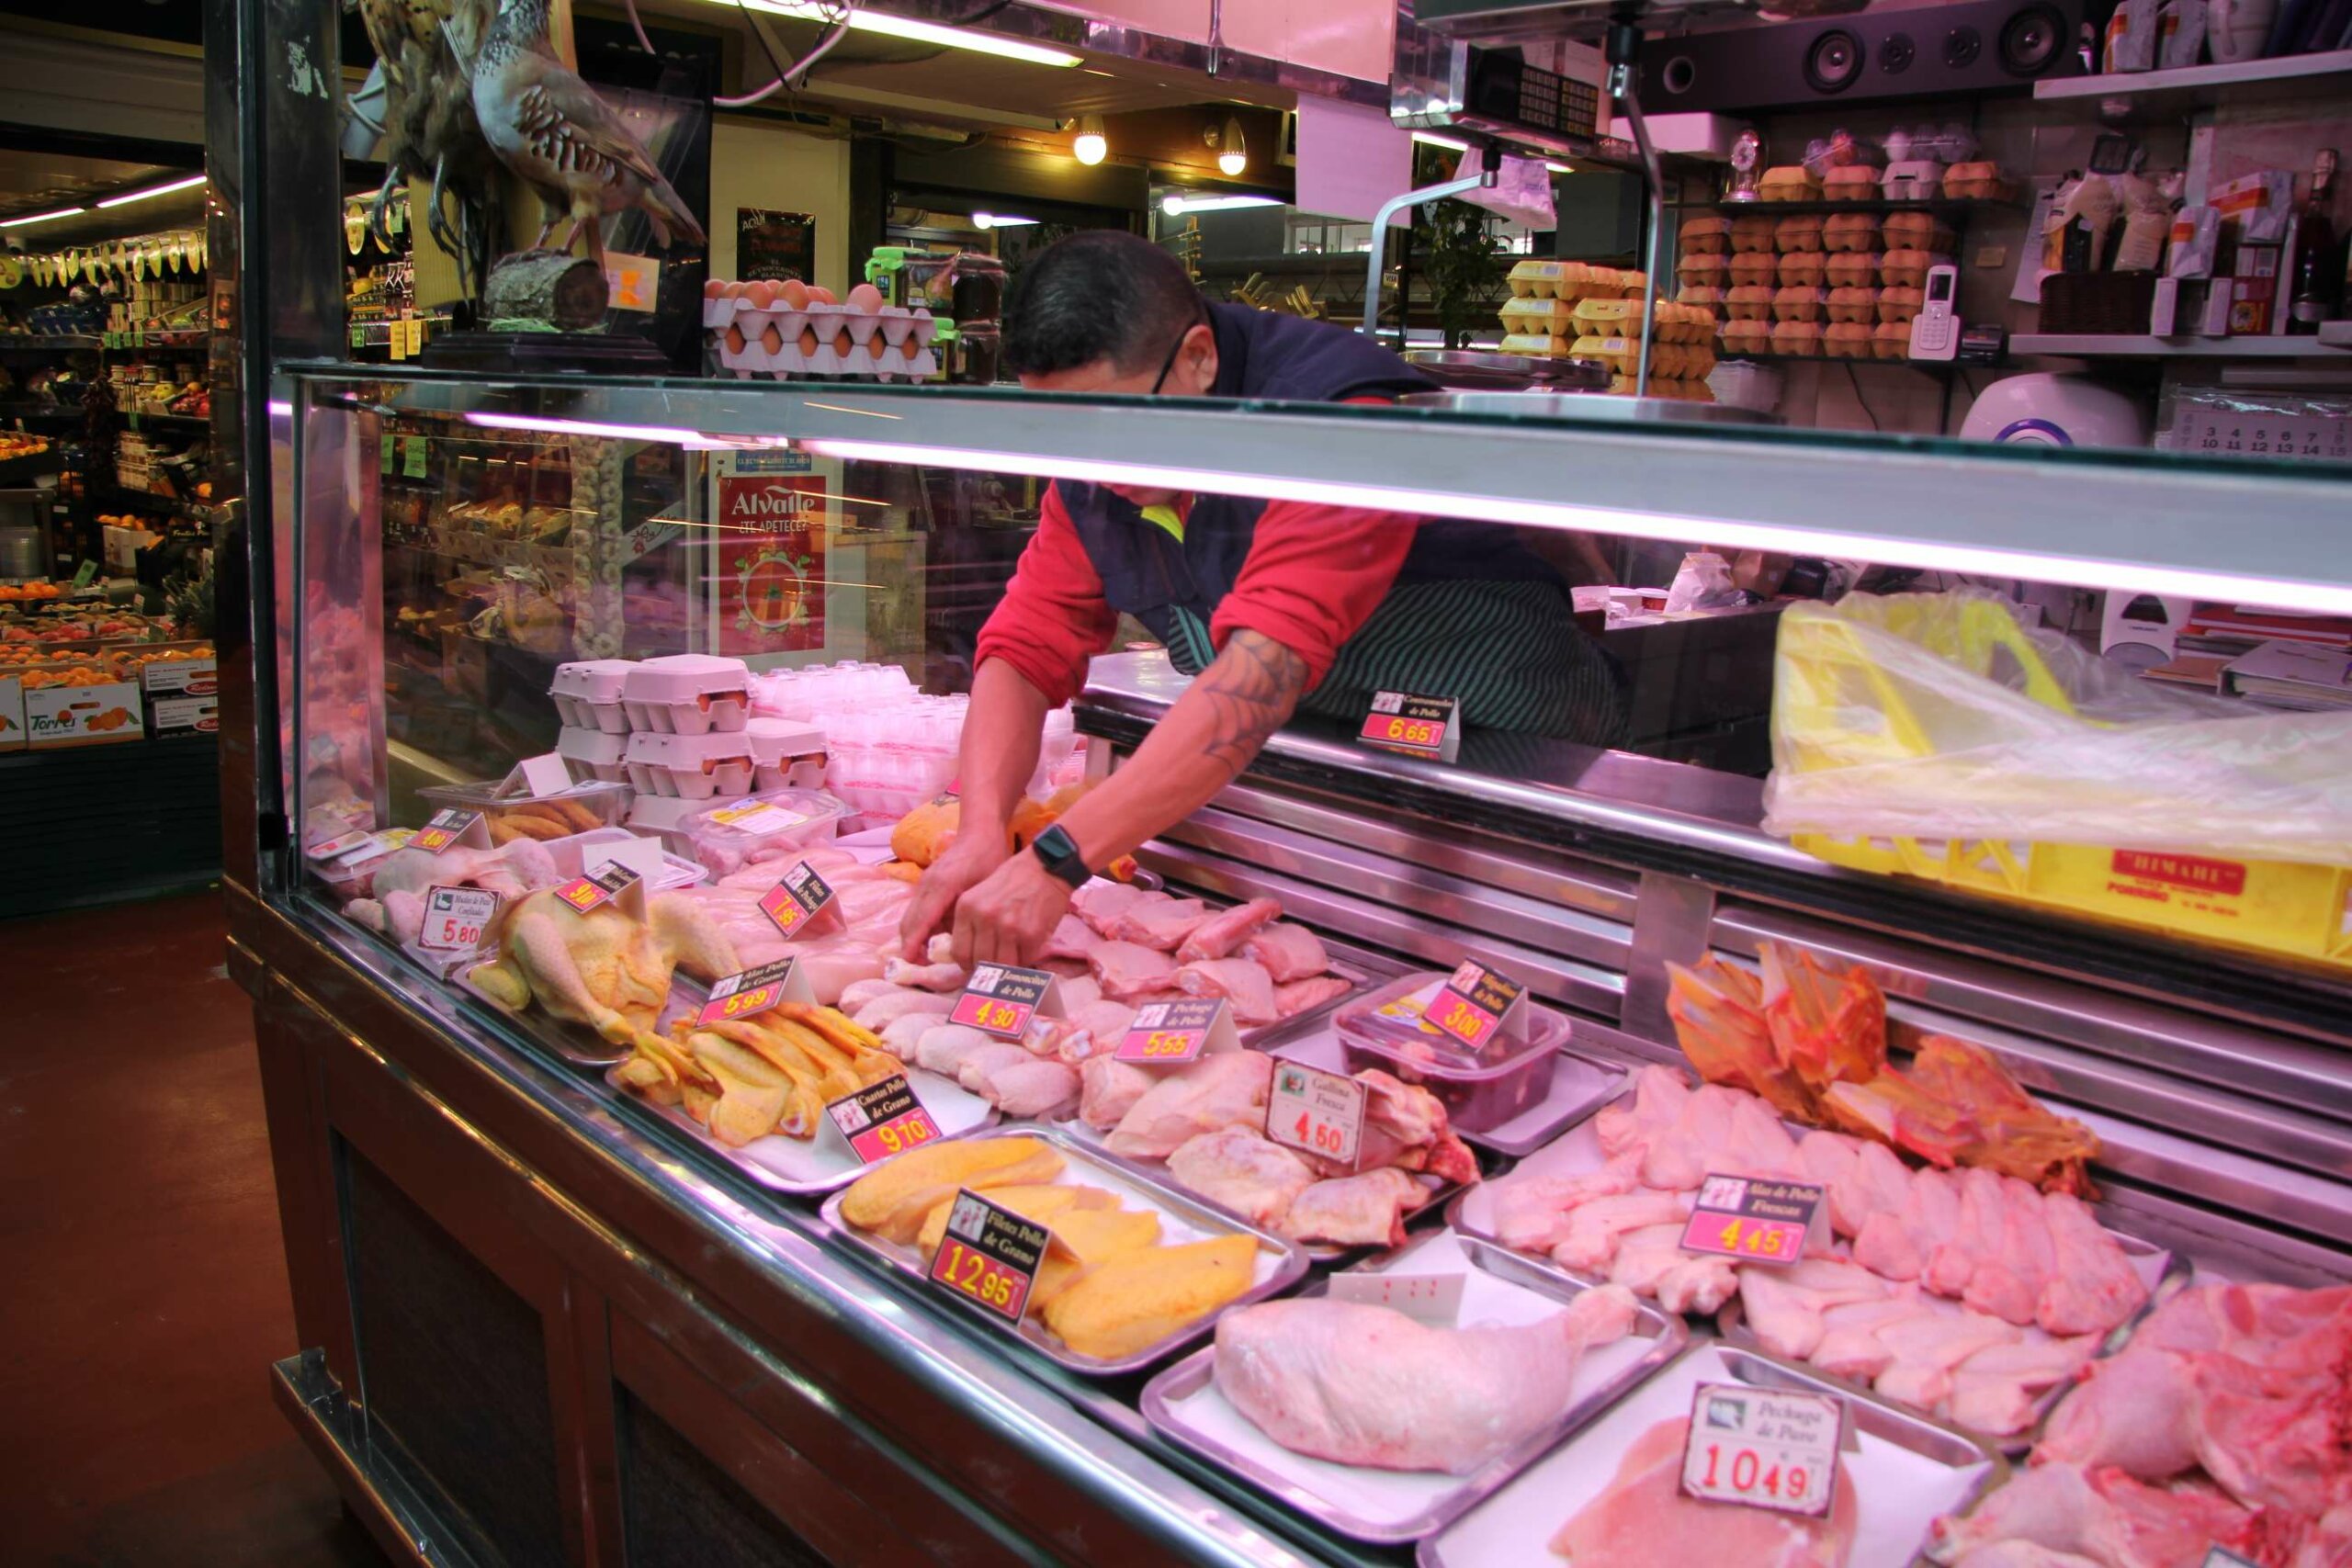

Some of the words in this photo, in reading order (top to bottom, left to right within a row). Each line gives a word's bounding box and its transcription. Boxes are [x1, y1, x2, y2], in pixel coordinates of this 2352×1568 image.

[2207, 427, 2216, 436] 3
[2231, 428, 2241, 438] 4
[2256, 430, 2266, 440] 5
[2280, 431, 2290, 441] 6
[2308, 433, 2317, 442] 7
[2201, 439, 2219, 449] 10
[2226, 440, 2242, 450] 11
[2251, 442, 2268, 452] 12
[2276, 444, 2293, 454] 13
[2301, 446, 2319, 455] 14
[731, 485, 815, 515] Alvalle
[759, 519, 807, 534] APETECE?
[1012, 986, 1035, 998] Pollo
[887, 1077, 908, 1095] Pollo
[871, 1107, 883, 1119] de
[883, 1095, 911, 1113] Grano
[1773, 1185, 1788, 1199] de
[986, 1210, 1019, 1235] Filetes
[1018, 1224, 1046, 1247] Pollo
[982, 1231, 998, 1247] de
[999, 1237, 1035, 1266] Grano
[1757, 1400, 1823, 1426] Pechuga
[1756, 1424, 1774, 1438] de
[1778, 1425, 1818, 1443] Pavo
